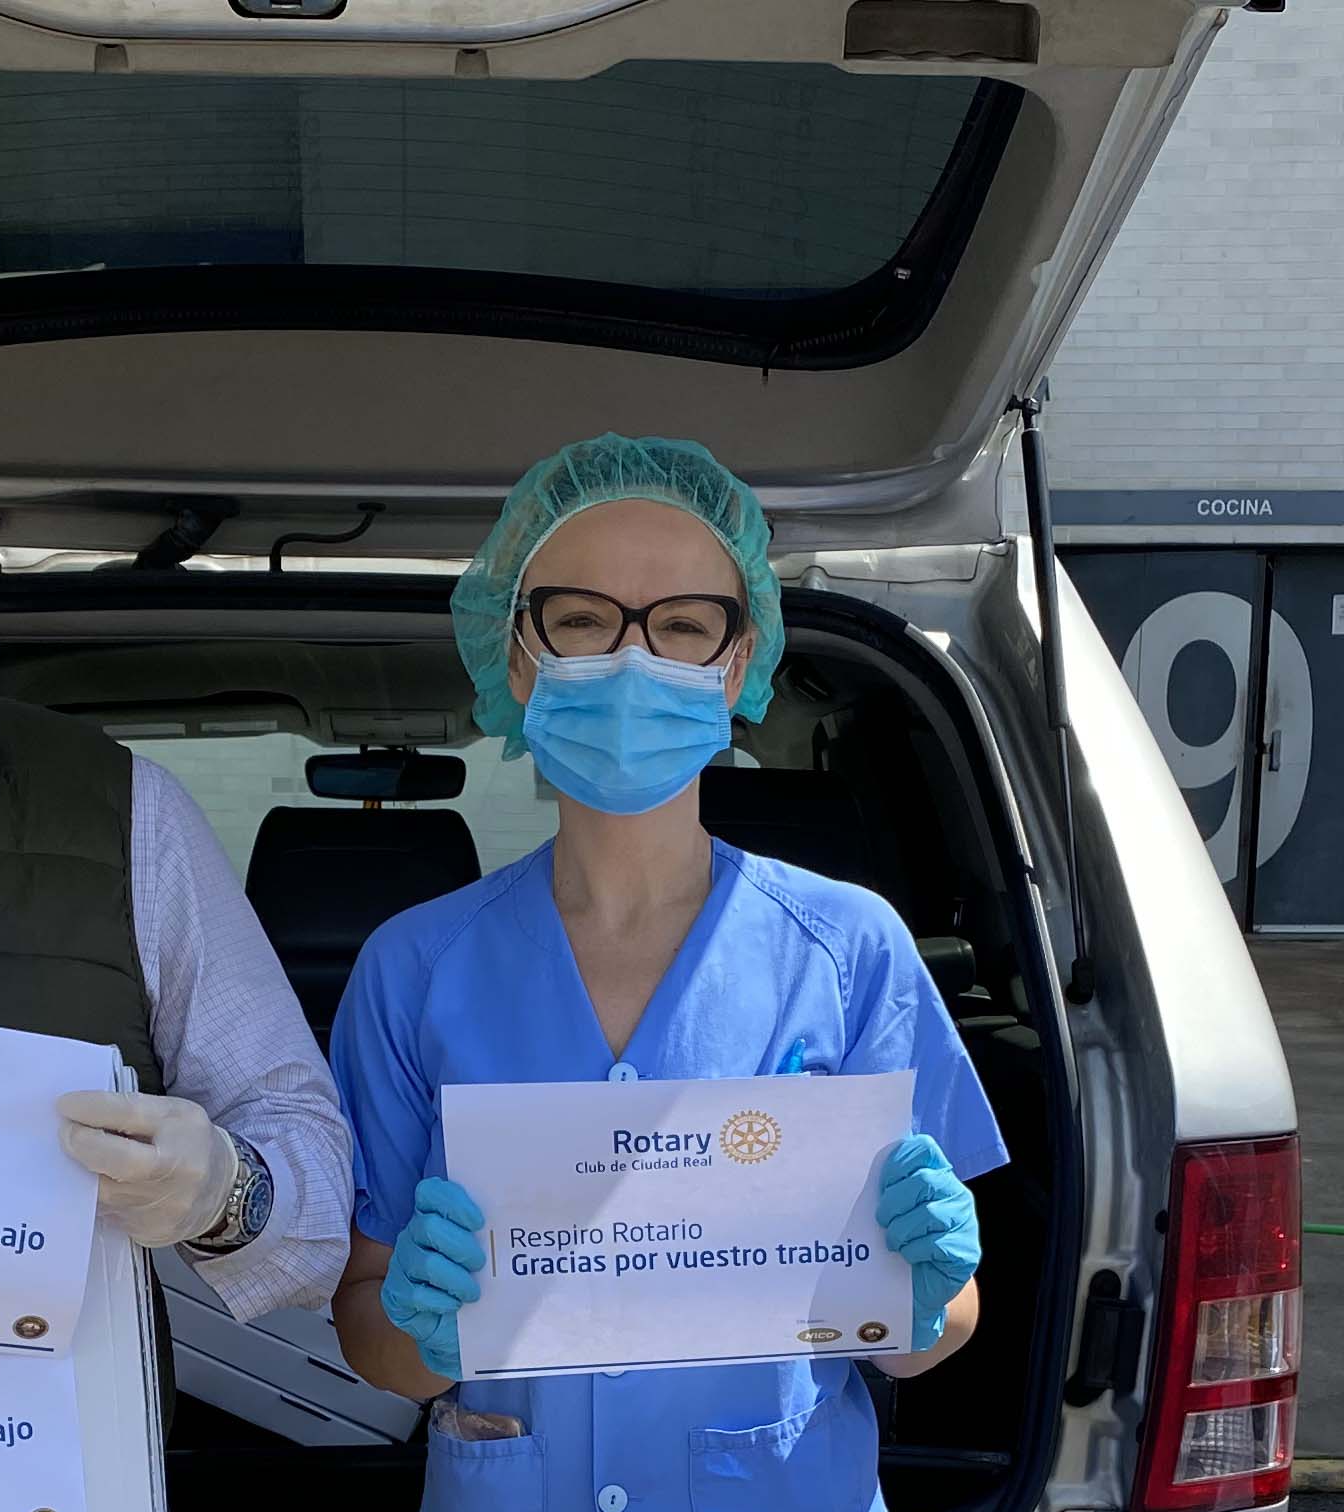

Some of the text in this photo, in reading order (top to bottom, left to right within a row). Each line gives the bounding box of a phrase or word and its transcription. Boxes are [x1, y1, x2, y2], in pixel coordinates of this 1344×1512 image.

[1196, 498, 1274, 517] COCINA
[1120, 590, 1314, 884] 9
[613, 1129, 712, 1155] Rotary
[576, 1155, 712, 1174] Club de Ciudad Real
[510, 1218, 702, 1249] Respiro Rotario
[511, 1238, 869, 1277] Gracias por vuestro trabajo
